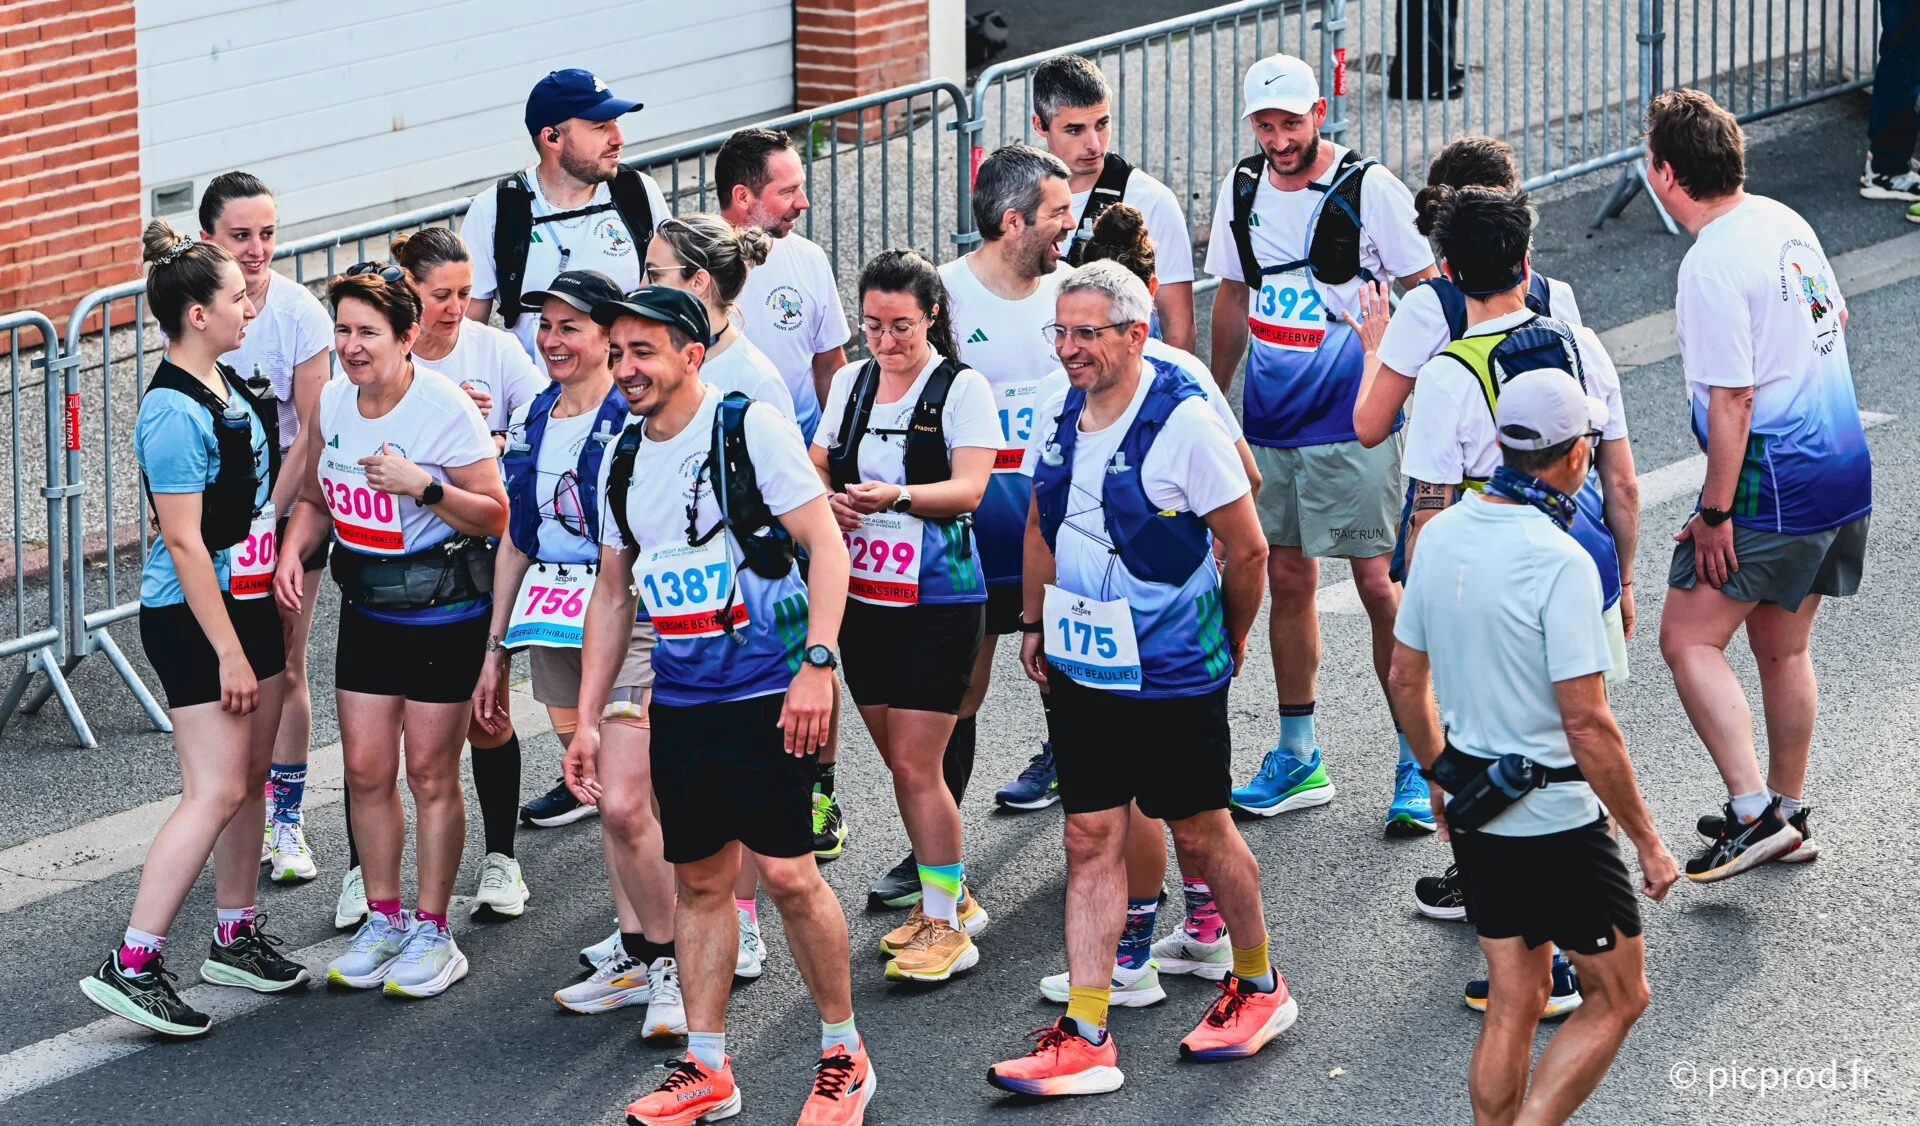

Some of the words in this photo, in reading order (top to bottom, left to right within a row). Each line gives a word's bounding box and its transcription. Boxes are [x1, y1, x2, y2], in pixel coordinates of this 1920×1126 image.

[1272, 329, 1323, 344] LEFEBVRE
[66, 410, 74, 448] ALTRAD
[322, 477, 393, 524] 3300
[1328, 528, 1357, 540] TRAIL
[1360, 528, 1384, 540] RUN
[524, 585, 586, 618] 756
[643, 562, 728, 608] 1387
[867, 585, 917, 599] BISSIRIEX
[1058, 617, 1118, 659] 175
[1051, 660, 1083, 676] EDRIC
[1085, 668, 1138, 681] BEAULIEU
